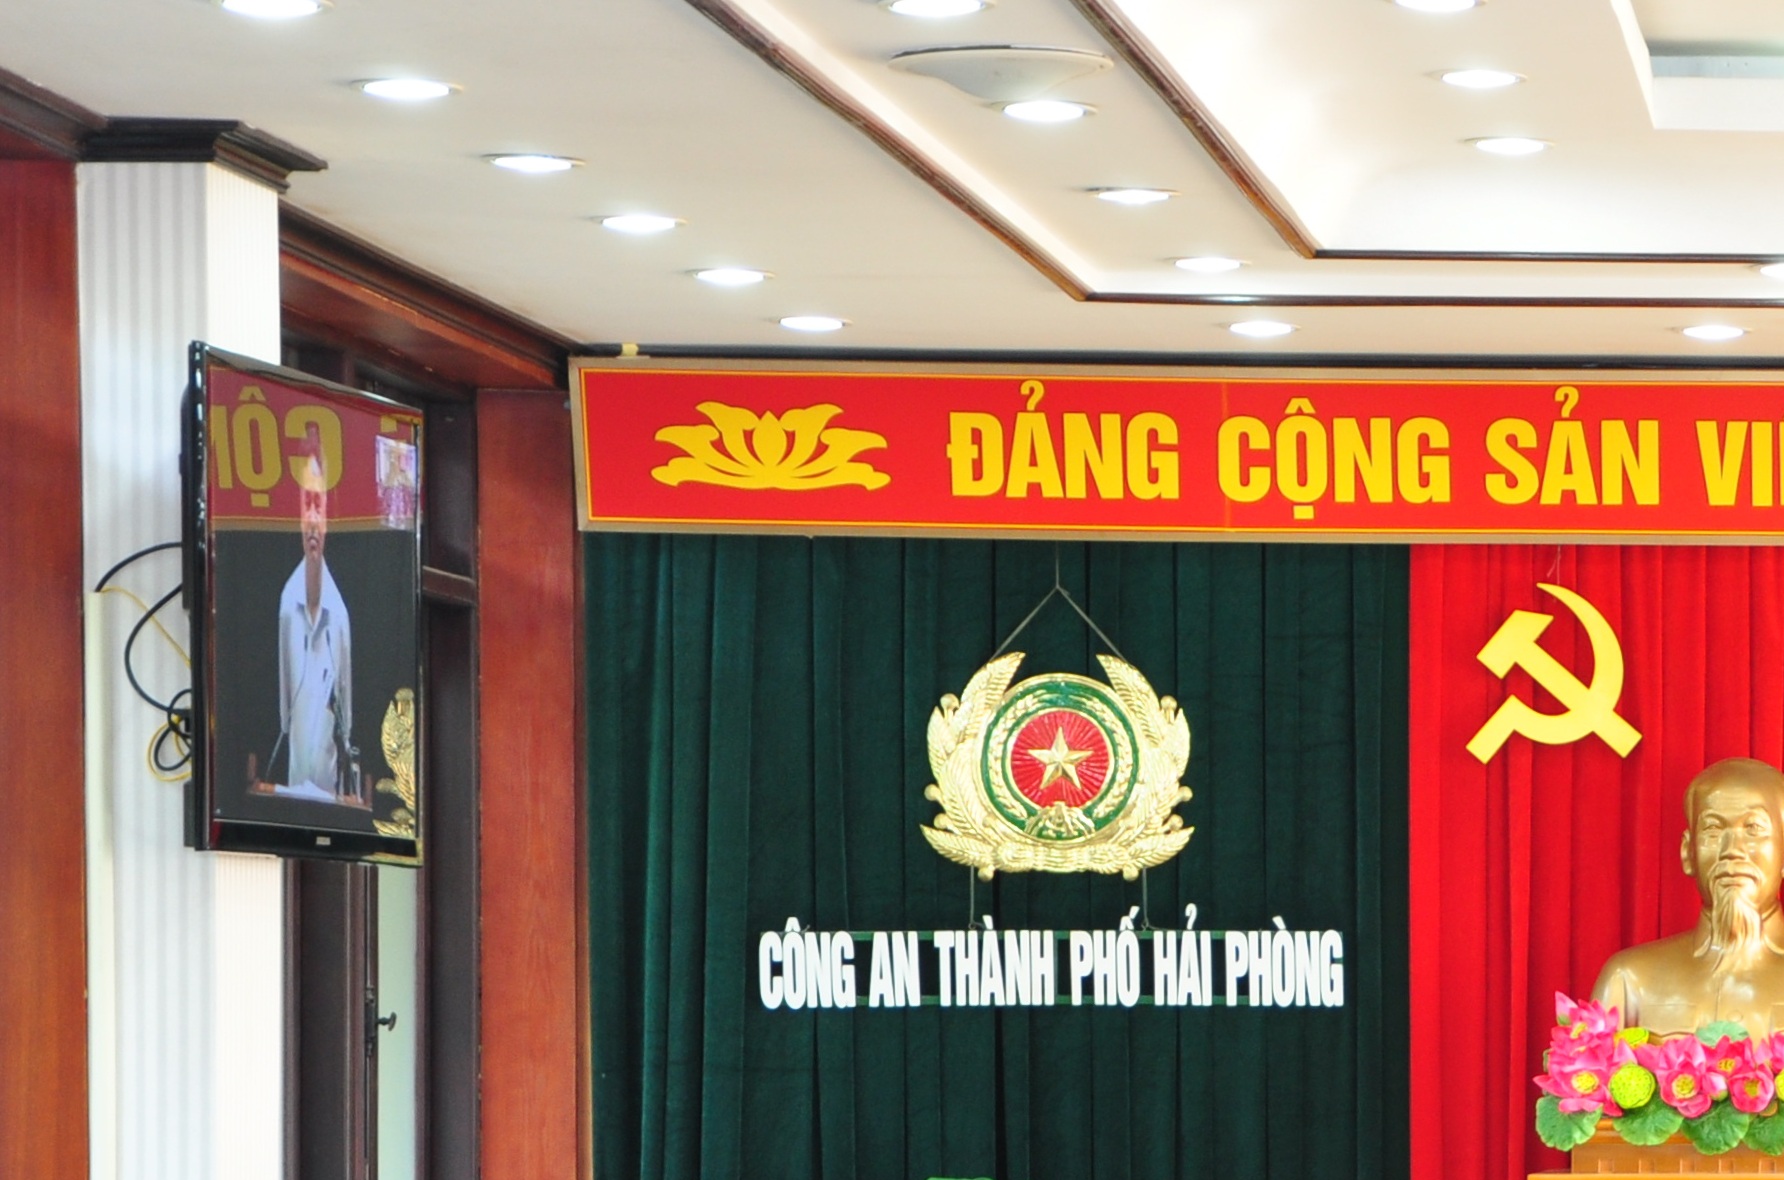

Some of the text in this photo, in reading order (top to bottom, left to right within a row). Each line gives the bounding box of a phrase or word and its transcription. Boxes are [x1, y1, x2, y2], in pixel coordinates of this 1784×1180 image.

[947, 380, 1180, 500] ĐẢNG
[1218, 398, 1451, 520] CỘNG
[1485, 386, 1660, 506] SẢN
[759, 903, 1344, 1009] CÔNG AN THÀNH PHỐ HẢI PHÒNG
